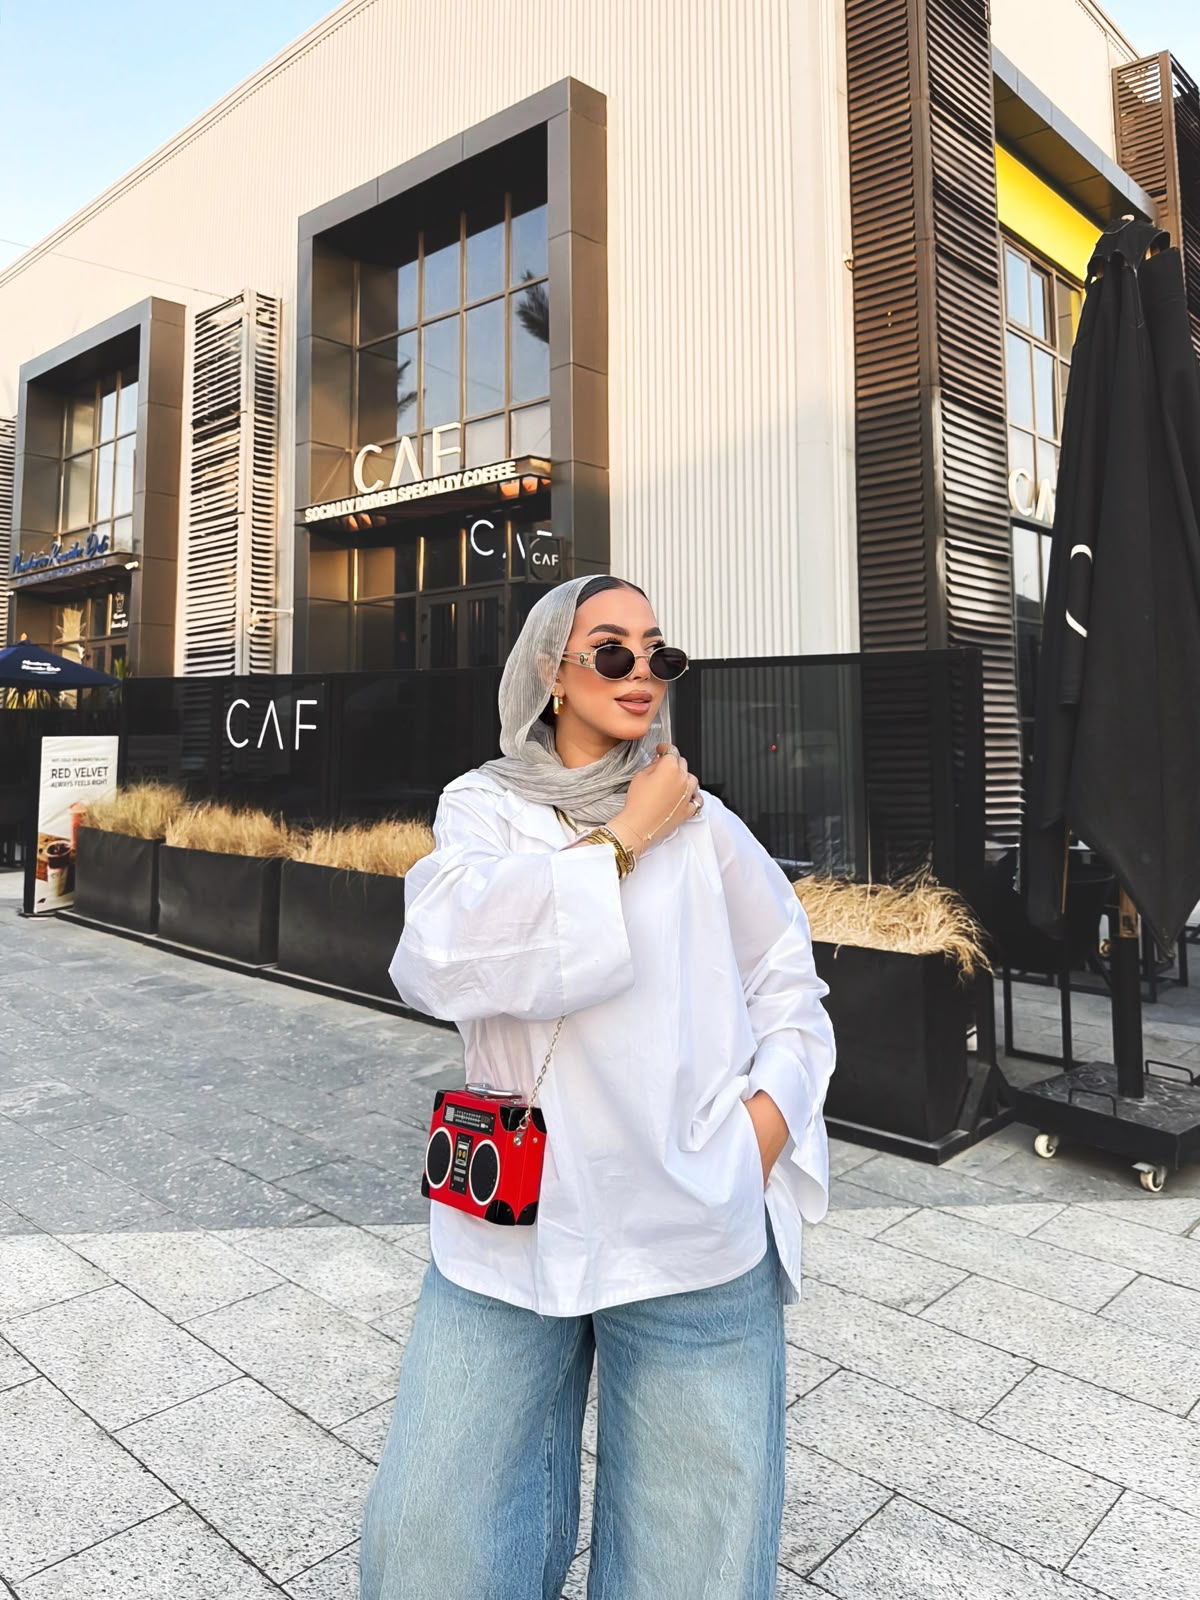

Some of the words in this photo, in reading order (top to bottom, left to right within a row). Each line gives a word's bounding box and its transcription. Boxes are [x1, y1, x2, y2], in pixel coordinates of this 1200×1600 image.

[353, 421, 462, 494] CAF
[304, 497, 356, 523] SOCIALLY
[356, 488, 398, 512] DRIVEN
[398, 473, 463, 502] SPECIALTY
[463, 461, 516, 487] COFFEE
[1008, 467, 1056, 524] CA
[532, 552, 559, 567] CAF
[226, 698, 318, 751] CAF
[51, 767, 72, 779] RED
[74, 766, 109, 778] VELVET
